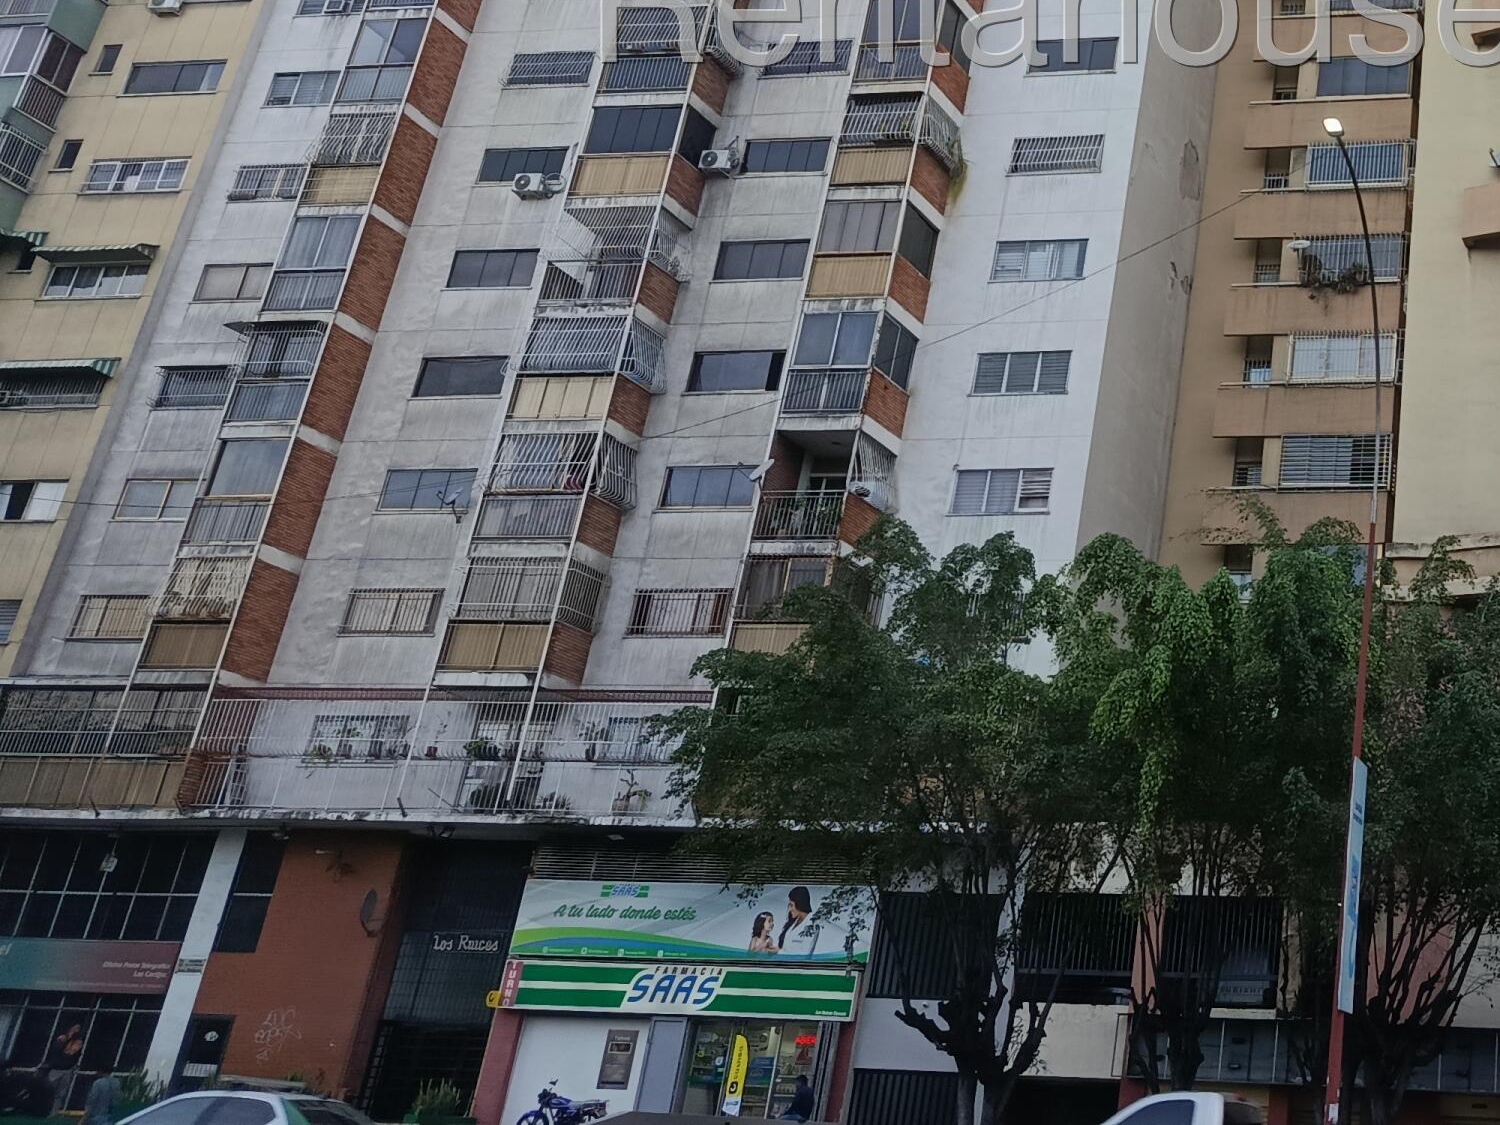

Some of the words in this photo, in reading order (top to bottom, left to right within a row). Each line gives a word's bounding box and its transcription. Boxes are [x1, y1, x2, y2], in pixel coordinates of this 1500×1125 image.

[553, 904, 568, 917] A
[568, 904, 583, 918] tu
[585, 904, 617, 919] lado
[619, 905, 661, 921] donde
[655, 966, 723, 976] FARMACIA
[501, 961, 518, 1006] TURNO
[626, 974, 720, 1005] SAAS
